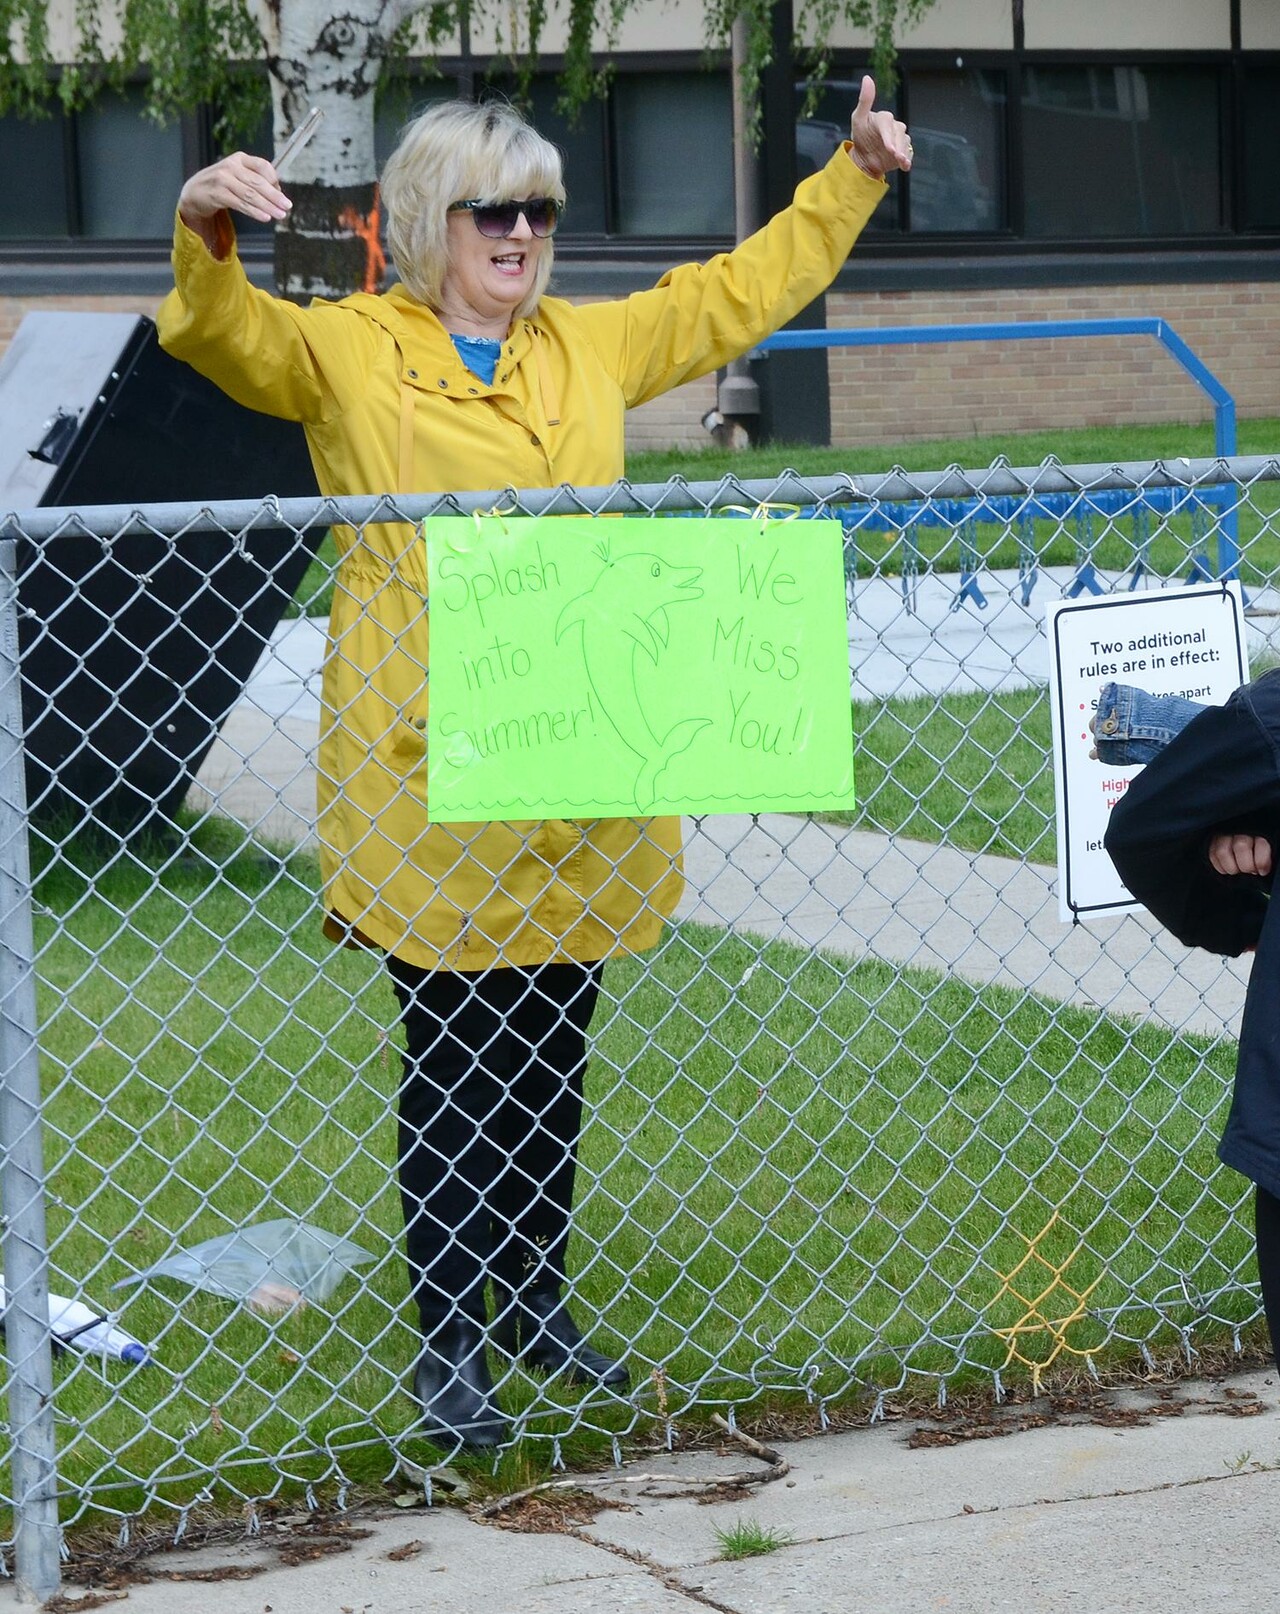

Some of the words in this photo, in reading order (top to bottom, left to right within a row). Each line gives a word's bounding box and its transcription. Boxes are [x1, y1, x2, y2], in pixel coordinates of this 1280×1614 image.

[438, 540, 561, 628] Splash
[736, 543, 803, 605] We
[458, 635, 531, 691] into
[712, 615, 800, 681] Miss
[1080, 662, 1118, 678] rules
[1122, 659, 1147, 673] are
[1151, 654, 1166, 669] in
[1170, 648, 1220, 667] effect:
[1090, 641, 1123, 655] Two
[1128, 628, 1206, 651] additional
[728, 689, 803, 756] You!
[1180, 685, 1212, 701] apart
[439, 691, 597, 769] Summer!
